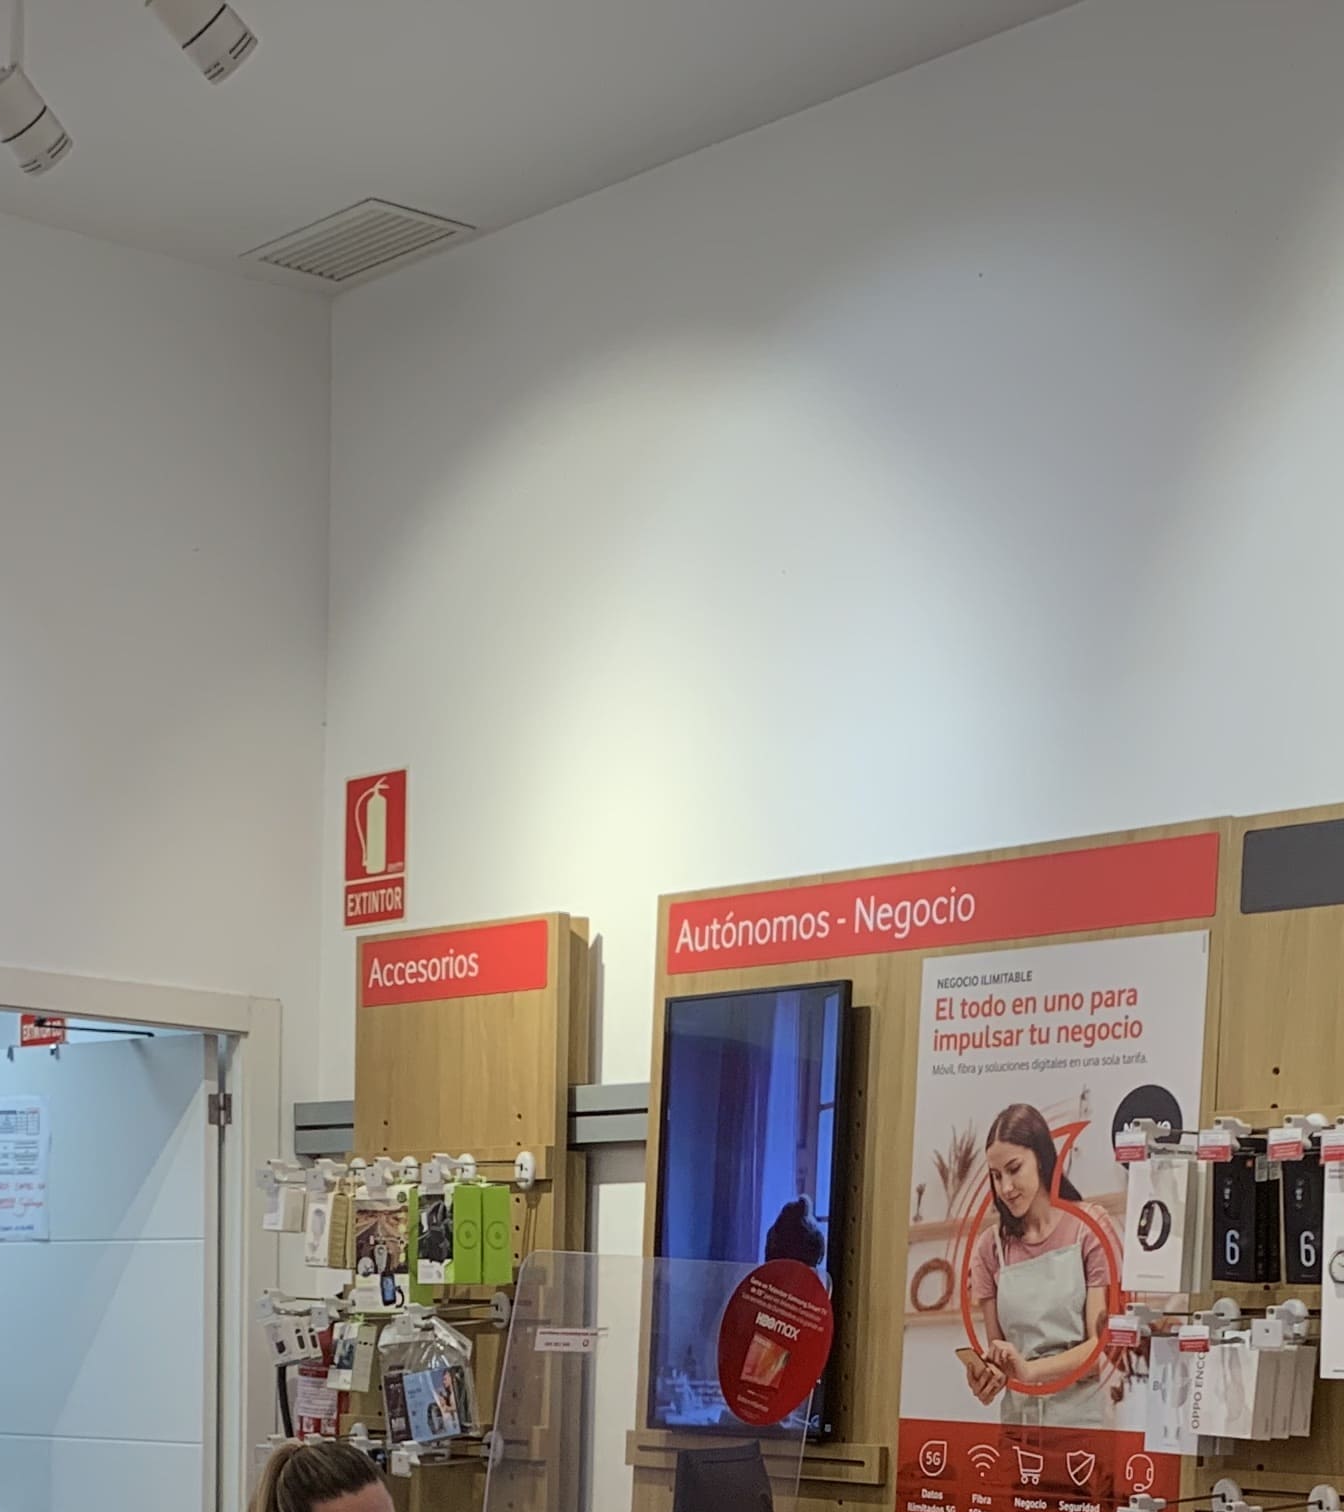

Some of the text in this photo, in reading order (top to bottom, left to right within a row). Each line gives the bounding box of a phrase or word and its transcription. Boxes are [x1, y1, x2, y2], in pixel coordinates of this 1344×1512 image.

[346, 887, 402, 917] EXTINTOR
[676, 909, 829, 954] Autónomos
[854, 886, 975, 938] Negocio
[368, 948, 479, 988] Accesorios
[937, 975, 979, 989] NEGOCIO
[935, 987, 1138, 1020] El todo en uno para
[933, 1015, 1143, 1056] impulsar tu negocio
[985, 1060, 1030, 1073] soluciones
[1031, 1057, 1067, 1071] digitales
[1069, 1058, 1081, 1068] en
[1082, 1056, 1100, 1067] una
[1101, 1053, 1120, 1065] sola
[1226, 1230, 1239, 1264] 6
[1300, 1230, 1315, 1267] 6
[1191, 1392, 1204, 1430] OPPO
[925, 1451, 941, 1467] 5G
[921, 1488, 943, 1500] Datos
[972, 1493, 992, 1505] Fibra
[1014, 1497, 1047, 1511] Negocio
